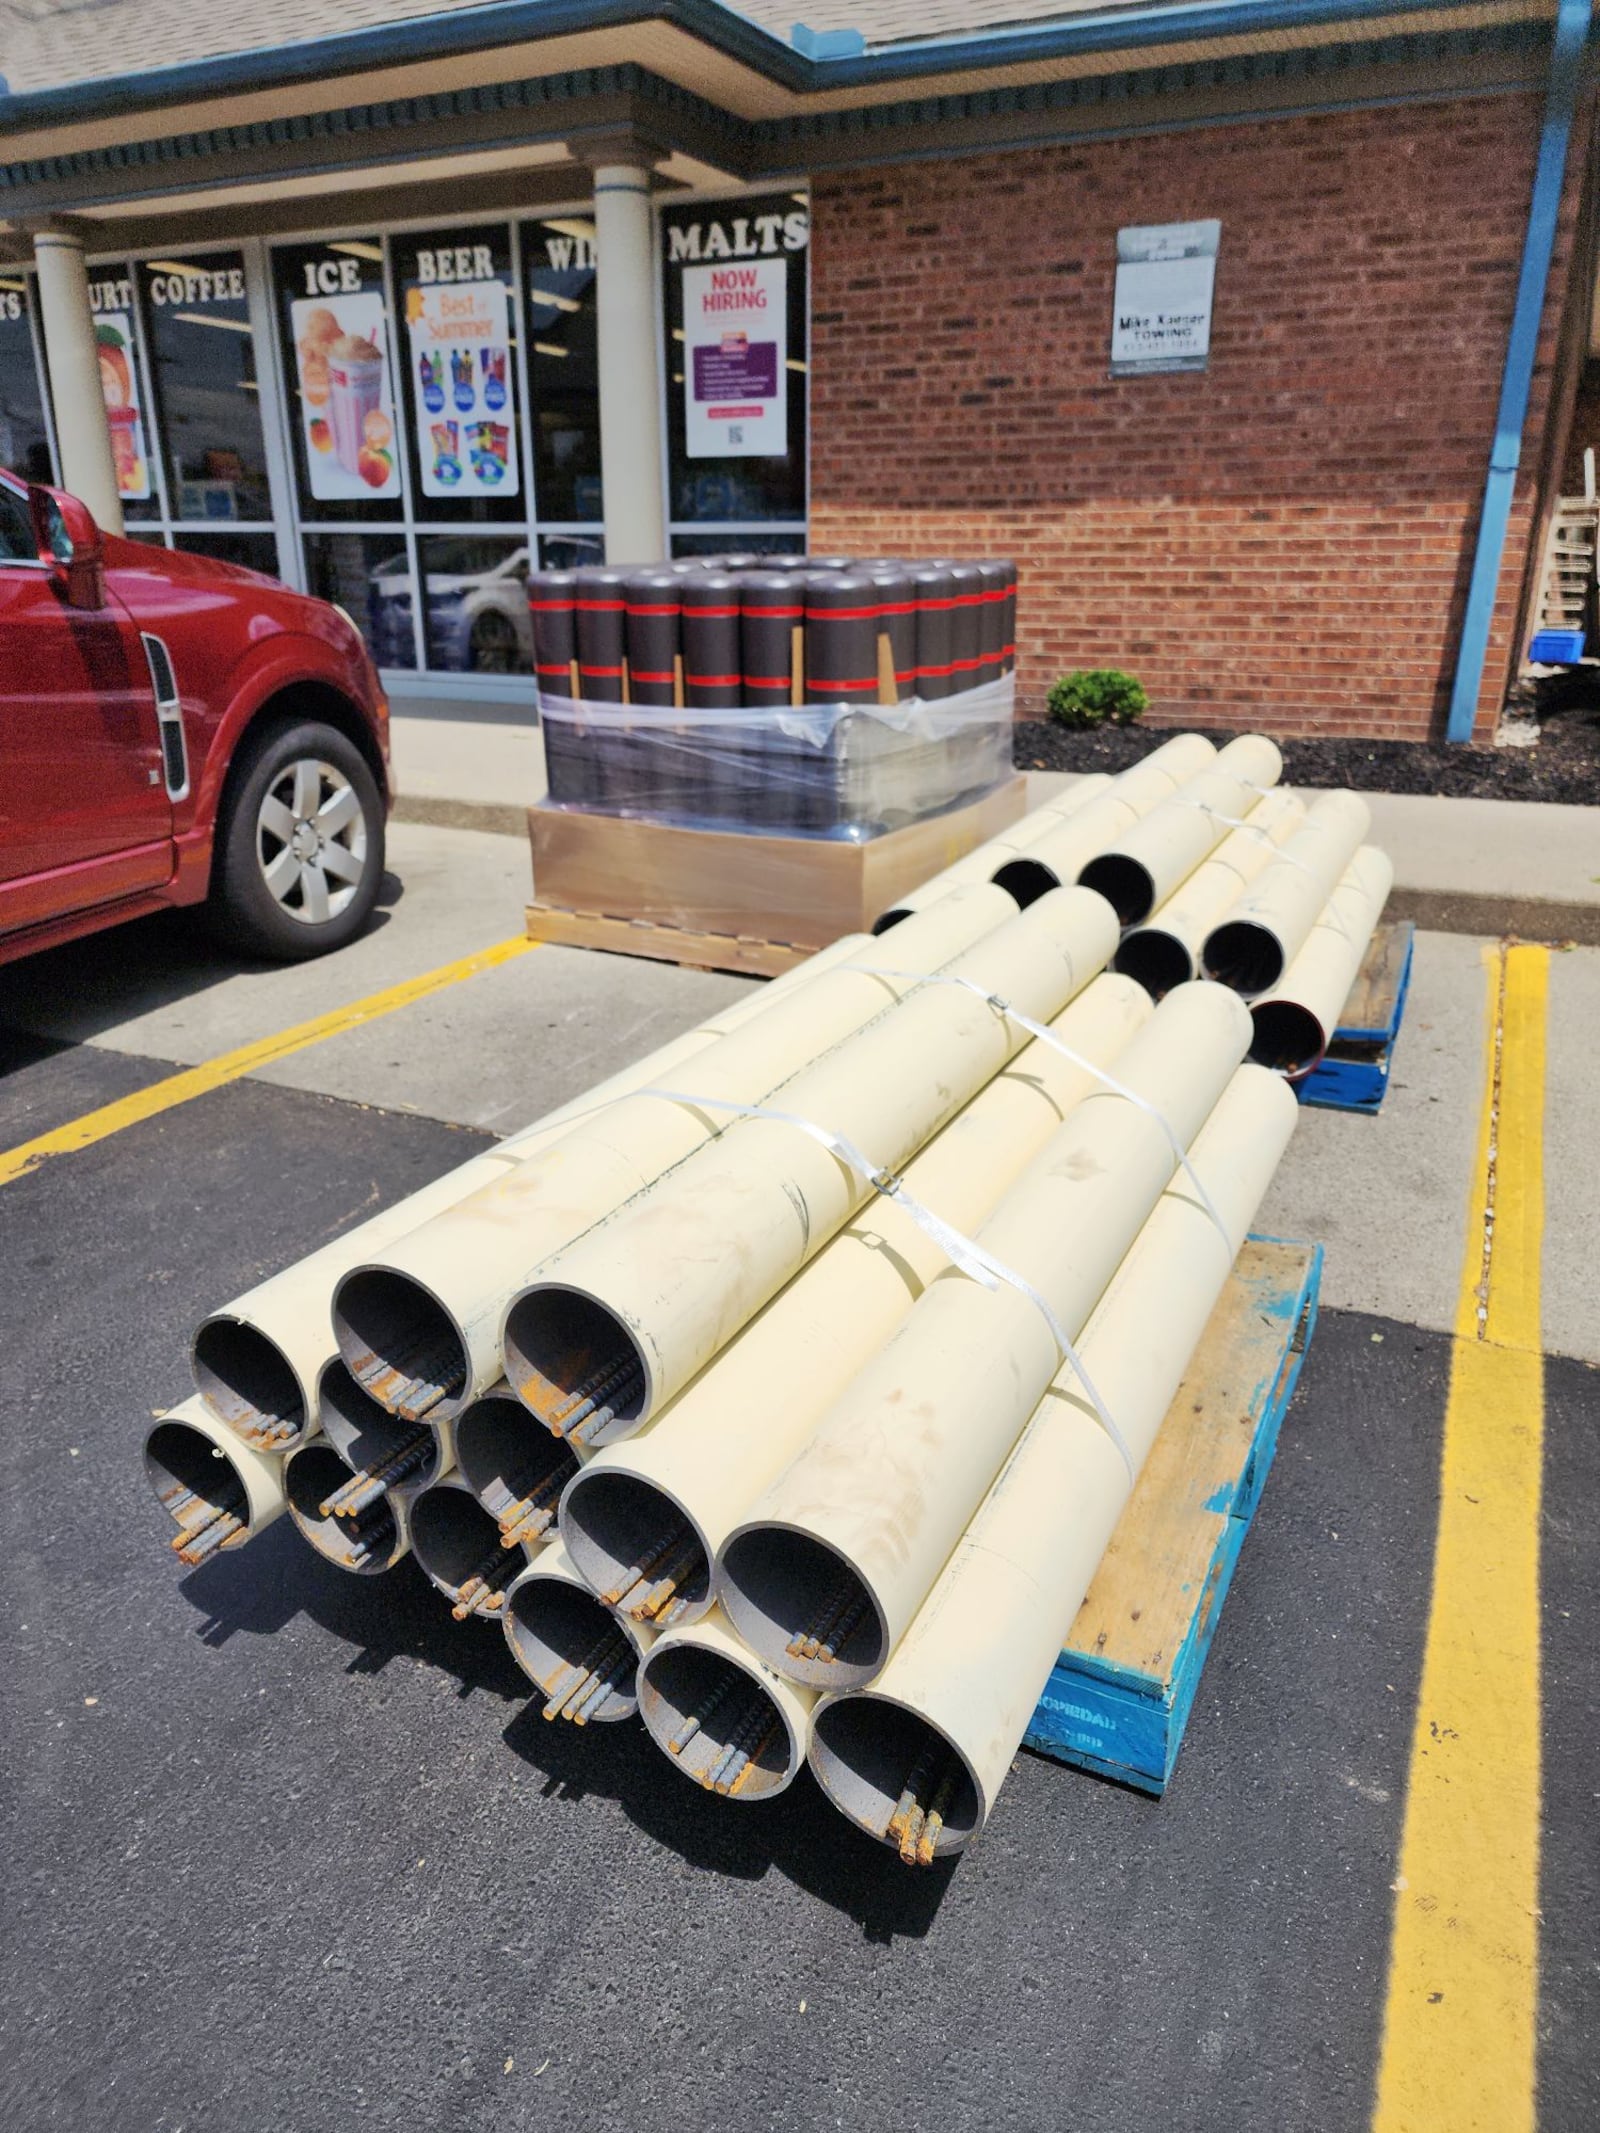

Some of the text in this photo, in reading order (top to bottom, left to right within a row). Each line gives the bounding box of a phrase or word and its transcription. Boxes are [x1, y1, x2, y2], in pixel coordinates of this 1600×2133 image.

[668, 212, 810, 262] MALTS
[304, 259, 362, 295] ICE
[416, 245, 495, 283] BEER
[712, 269, 758, 290] NOW
[88, 280, 130, 312] URT
[150, 269, 245, 306] COFFEE
[702, 288, 768, 312] HIRING
